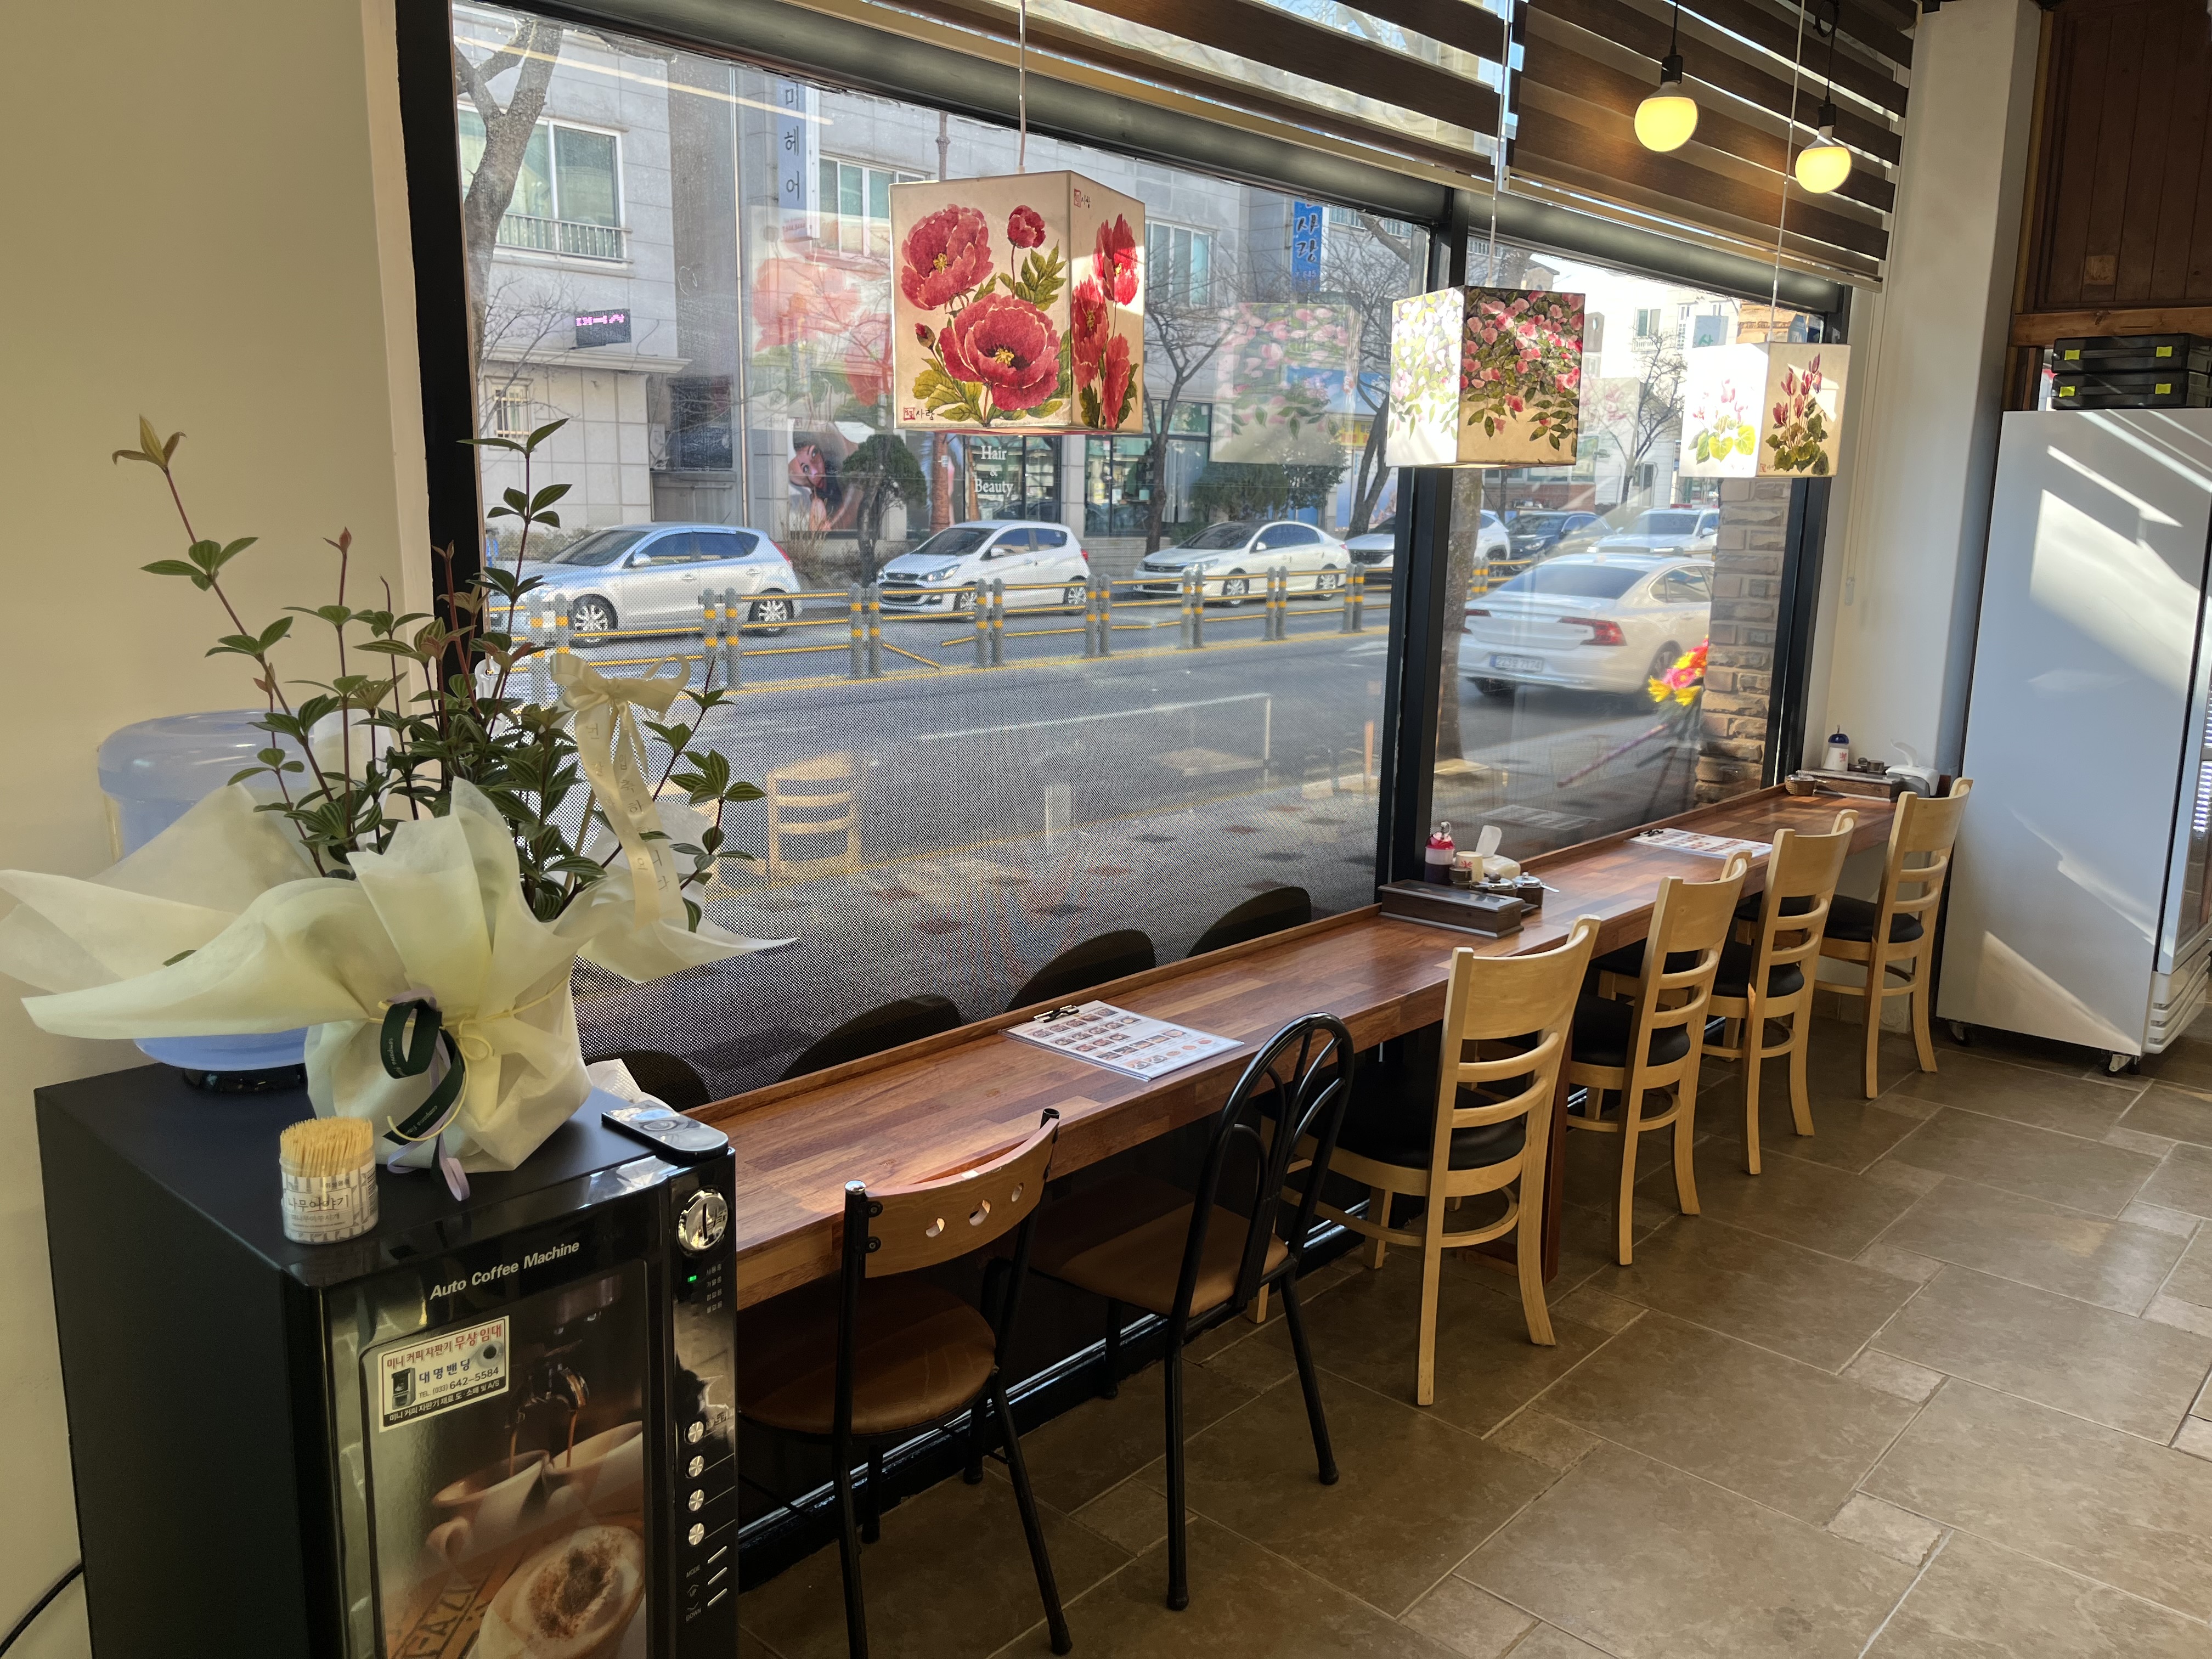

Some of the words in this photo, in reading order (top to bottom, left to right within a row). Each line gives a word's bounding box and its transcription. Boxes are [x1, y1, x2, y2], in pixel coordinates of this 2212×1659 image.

[1296, 214, 1319, 263] 사랑
[916, 408, 935, 420] 사랑
[980, 445, 1007, 460] Hair
[990, 467, 998, 477] &
[974, 479, 1014, 498] Beauty
[287, 1194, 348, 1212] 나무이야기
[430, 1280, 467, 1300] Auto
[472, 1262, 519, 1286] Coffee
[523, 1242, 580, 1269] Machine
[387, 1358, 404, 1369] 미니
[407, 1351, 424, 1364] 커피
[425, 1341, 452, 1358] 자판기
[432, 1384, 448, 1395] (033)
[449, 1367, 499, 1390] 642-5584
[389, 1411, 403, 1421] 미니
[404, 1407, 418, 1417] 커피
[419, 1400, 439, 1413] 자판기
[441, 1395, 455, 1405] 재료
[686, 1564, 701, 1578] MODE
[686, 1607, 702, 1621] DOWN
